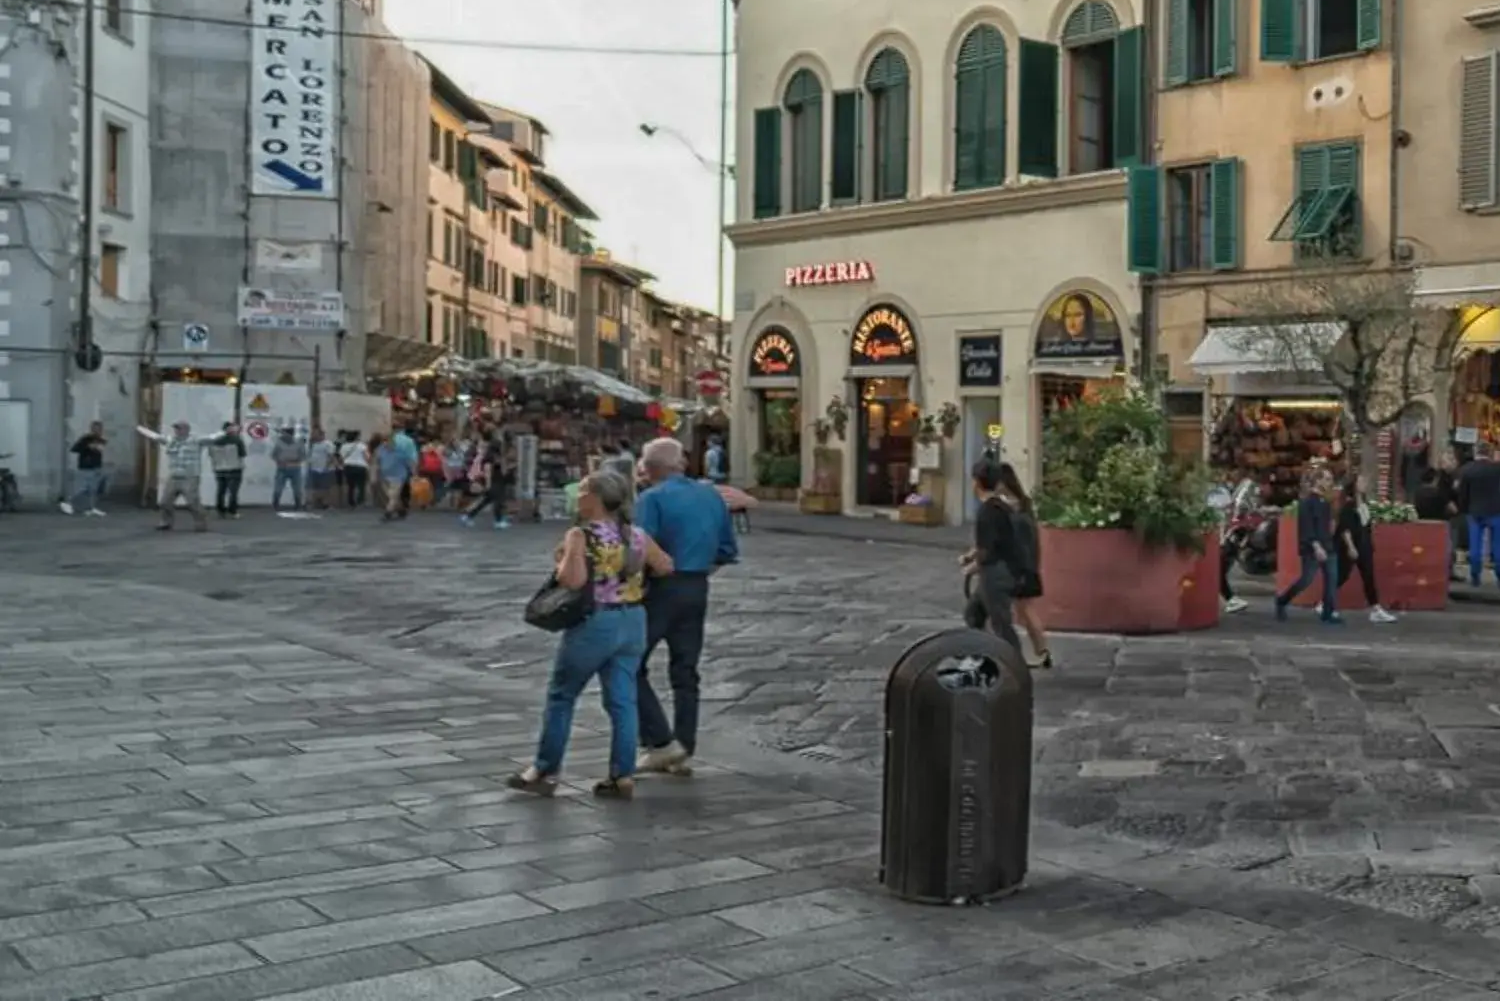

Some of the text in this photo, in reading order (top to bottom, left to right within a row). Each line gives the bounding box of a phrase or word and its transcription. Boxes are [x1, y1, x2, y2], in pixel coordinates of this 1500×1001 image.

[299, 57, 325, 174] LORENZO
[784, 260, 874, 287] PIZZERIA
[753, 334, 795, 364] PIZZERIA
[853, 309, 913, 354] RISTORANTE
